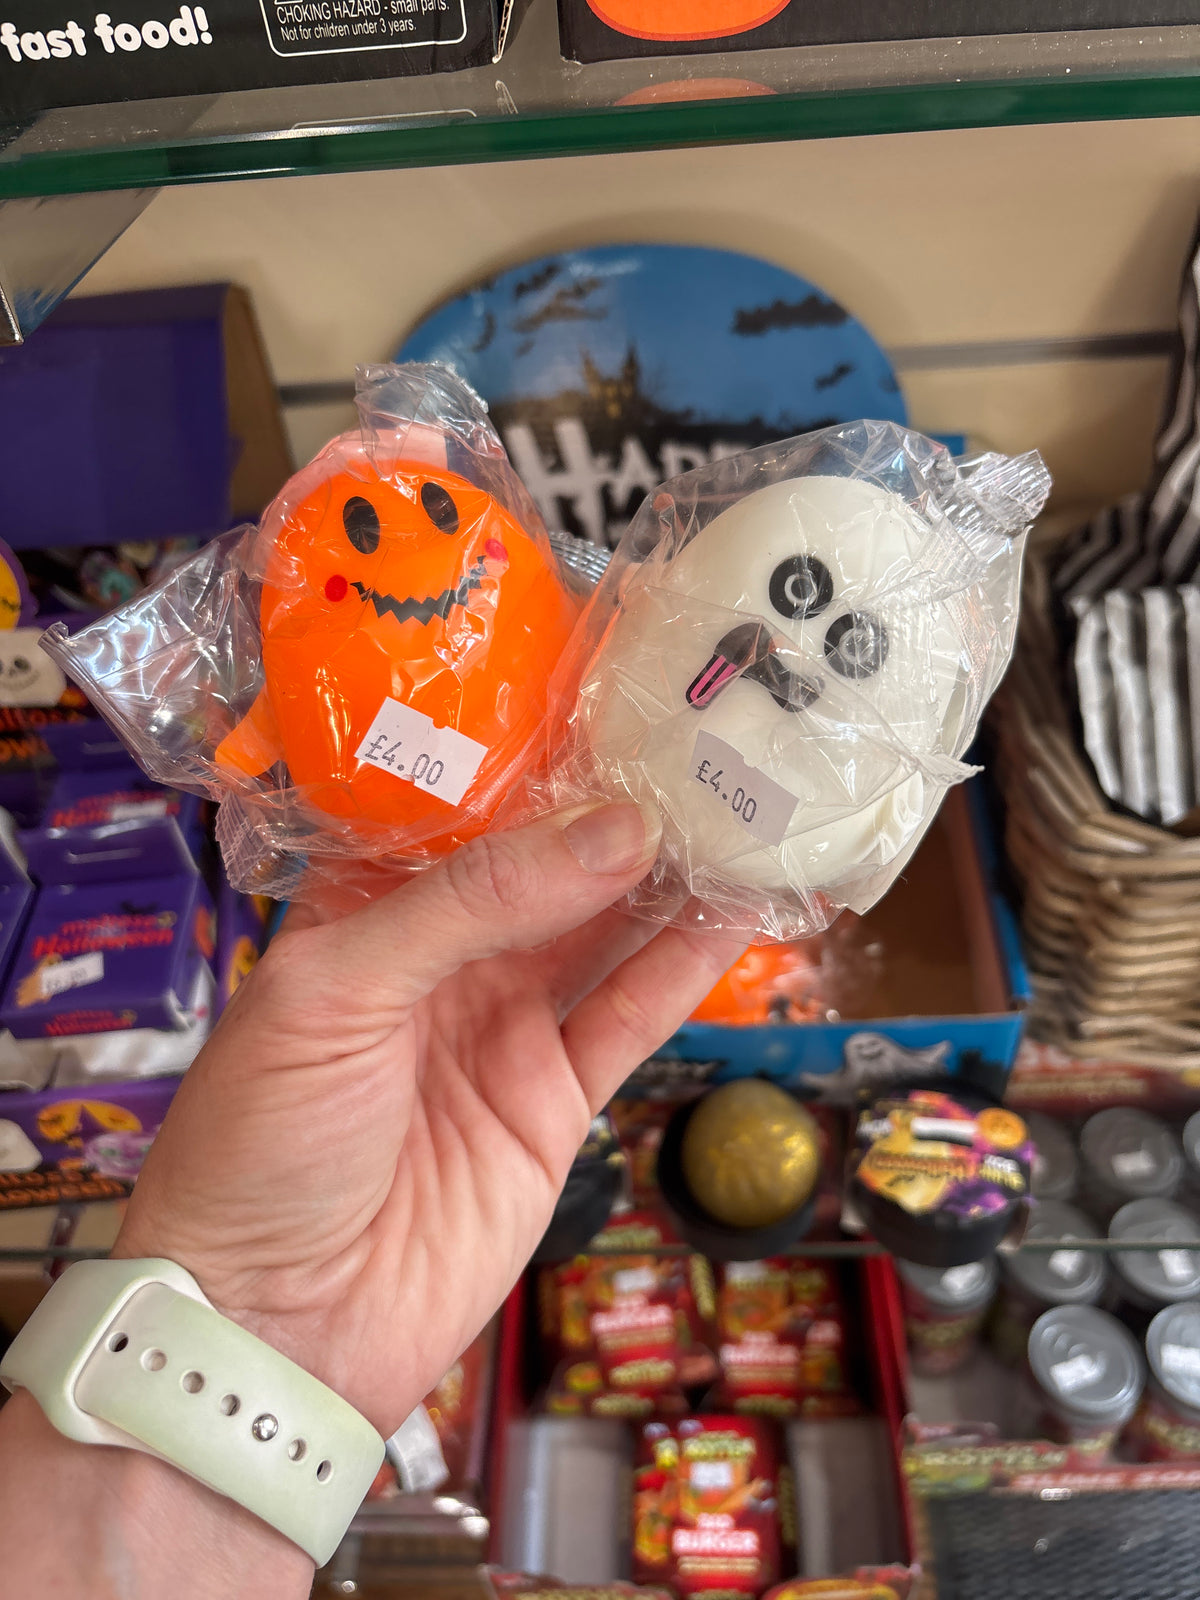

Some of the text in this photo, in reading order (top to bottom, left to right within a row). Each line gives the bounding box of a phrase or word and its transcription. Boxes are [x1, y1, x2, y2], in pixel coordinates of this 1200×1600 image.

[0, 5, 213, 62] fast food!
[275, 2, 331, 24] CHOKING
[332, 0, 381, 19] HAZARD
[390, 0, 419, 15] small
[420, 0, 450, 15] parts.
[280, 17, 417, 41] Not for children under 3 years.
[364, 734, 445, 786] £4.00
[695, 759, 757, 823] £4.00
